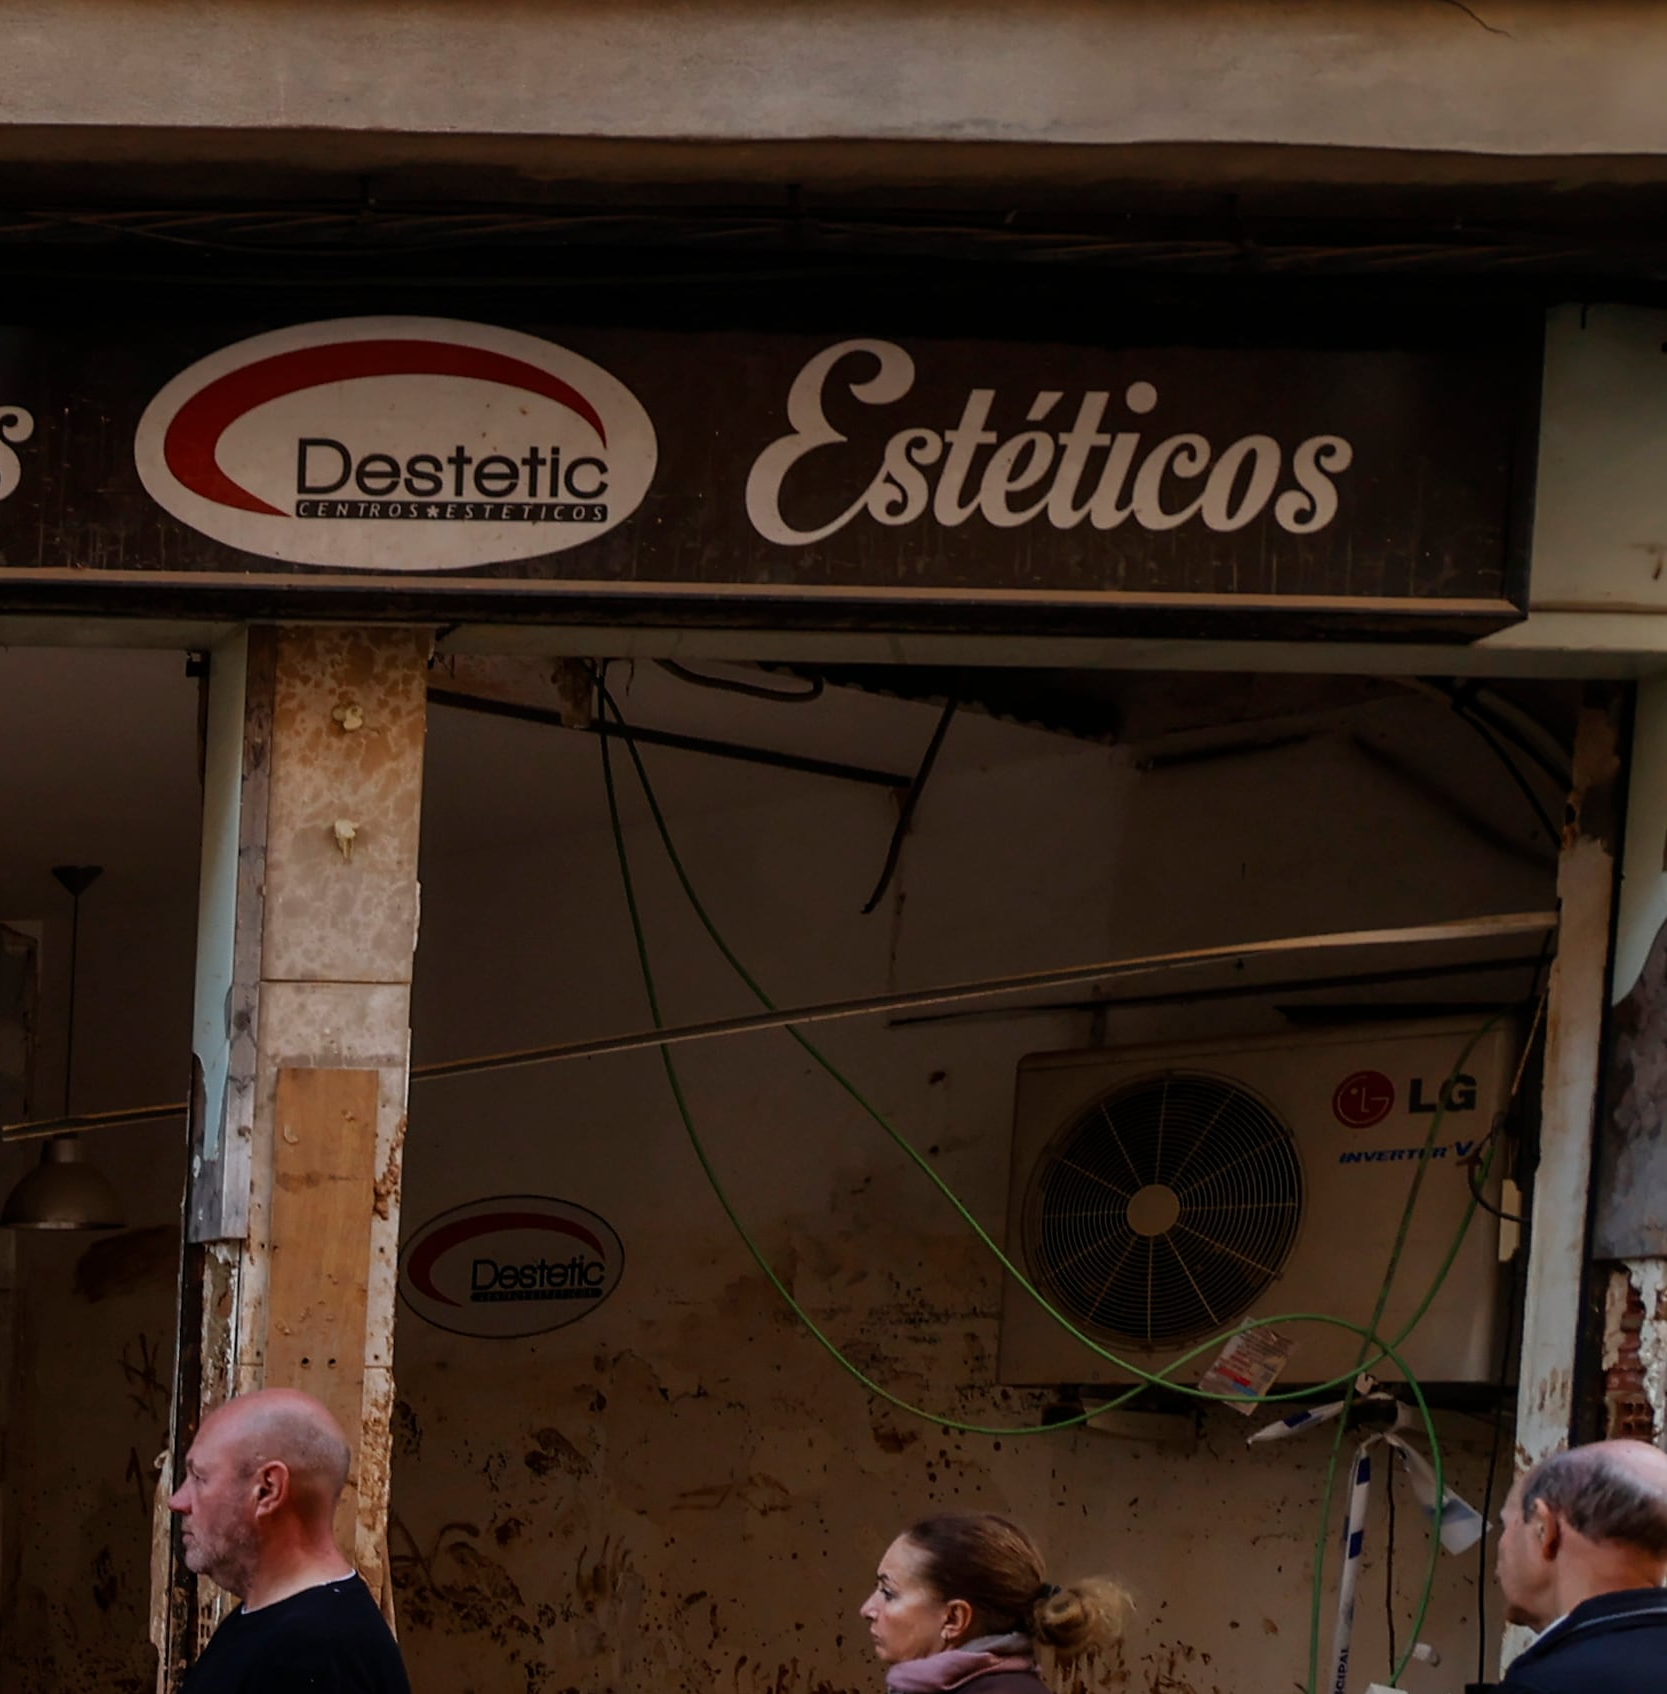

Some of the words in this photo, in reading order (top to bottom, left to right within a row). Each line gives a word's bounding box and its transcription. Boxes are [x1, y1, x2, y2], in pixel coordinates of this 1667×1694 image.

[745, 338, 1354, 546] Estéticos
[297, 437, 609, 500] Destetic
[297, 502, 420, 519] CENTROS
[445, 504, 605, 522] ESTETICOS
[1408, 1074, 1477, 1113] LG
[470, 1255, 606, 1291] Destetic
